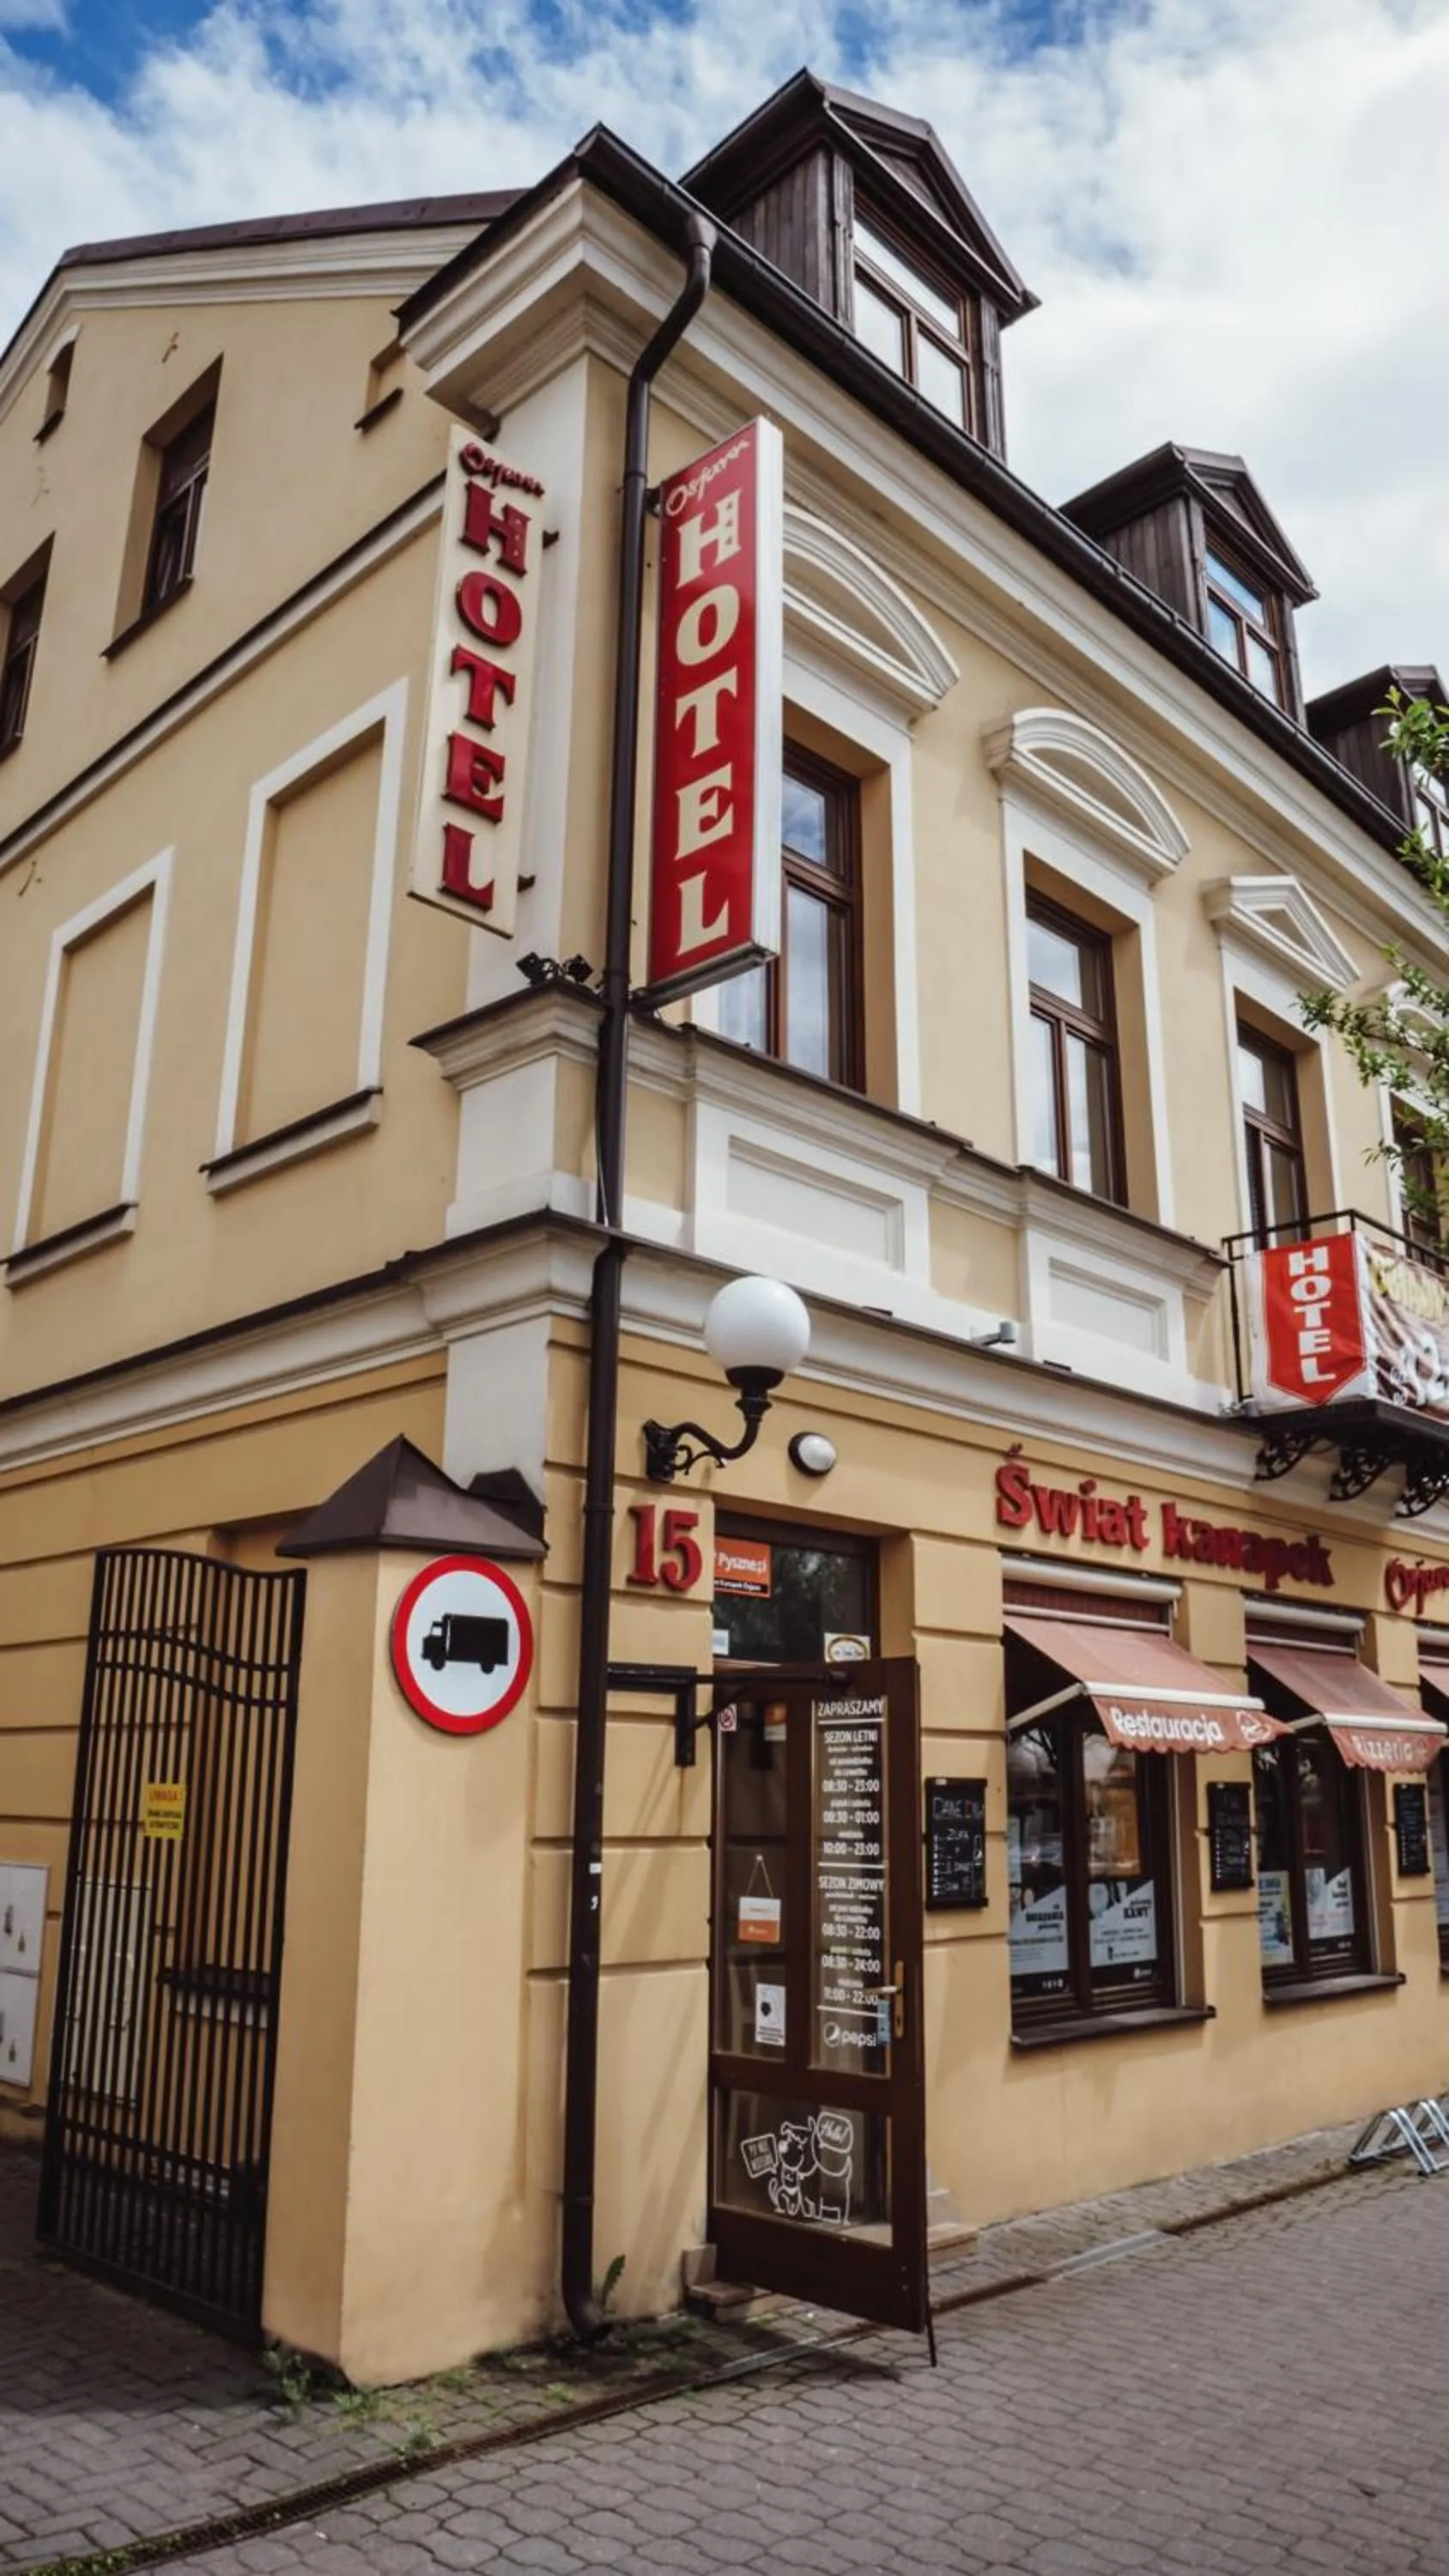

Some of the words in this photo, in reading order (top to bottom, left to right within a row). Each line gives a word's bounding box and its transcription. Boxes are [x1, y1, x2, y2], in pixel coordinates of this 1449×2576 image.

[438, 479, 530, 911] HOTEL
[675, 488, 743, 957] HOTEL
[1288, 1246, 1336, 1384] HOTEL
[994, 1443, 1149, 1551] Świat
[1161, 1502, 1335, 1590] kanapek
[626, 1504, 702, 1592] 15
[818, 1699, 884, 1716] ZAPRASZAMY
[1110, 1706, 1225, 1746] Restauracja
[824, 1730, 852, 1744] SEZON
[853, 1729, 878, 1742] LETNI
[818, 1875, 847, 1890] SEZON
[848, 1877, 884, 1892] ZIMOWY
[854, 1926, 881, 1941] 22:00
[841, 2030, 877, 2048] pepsi
